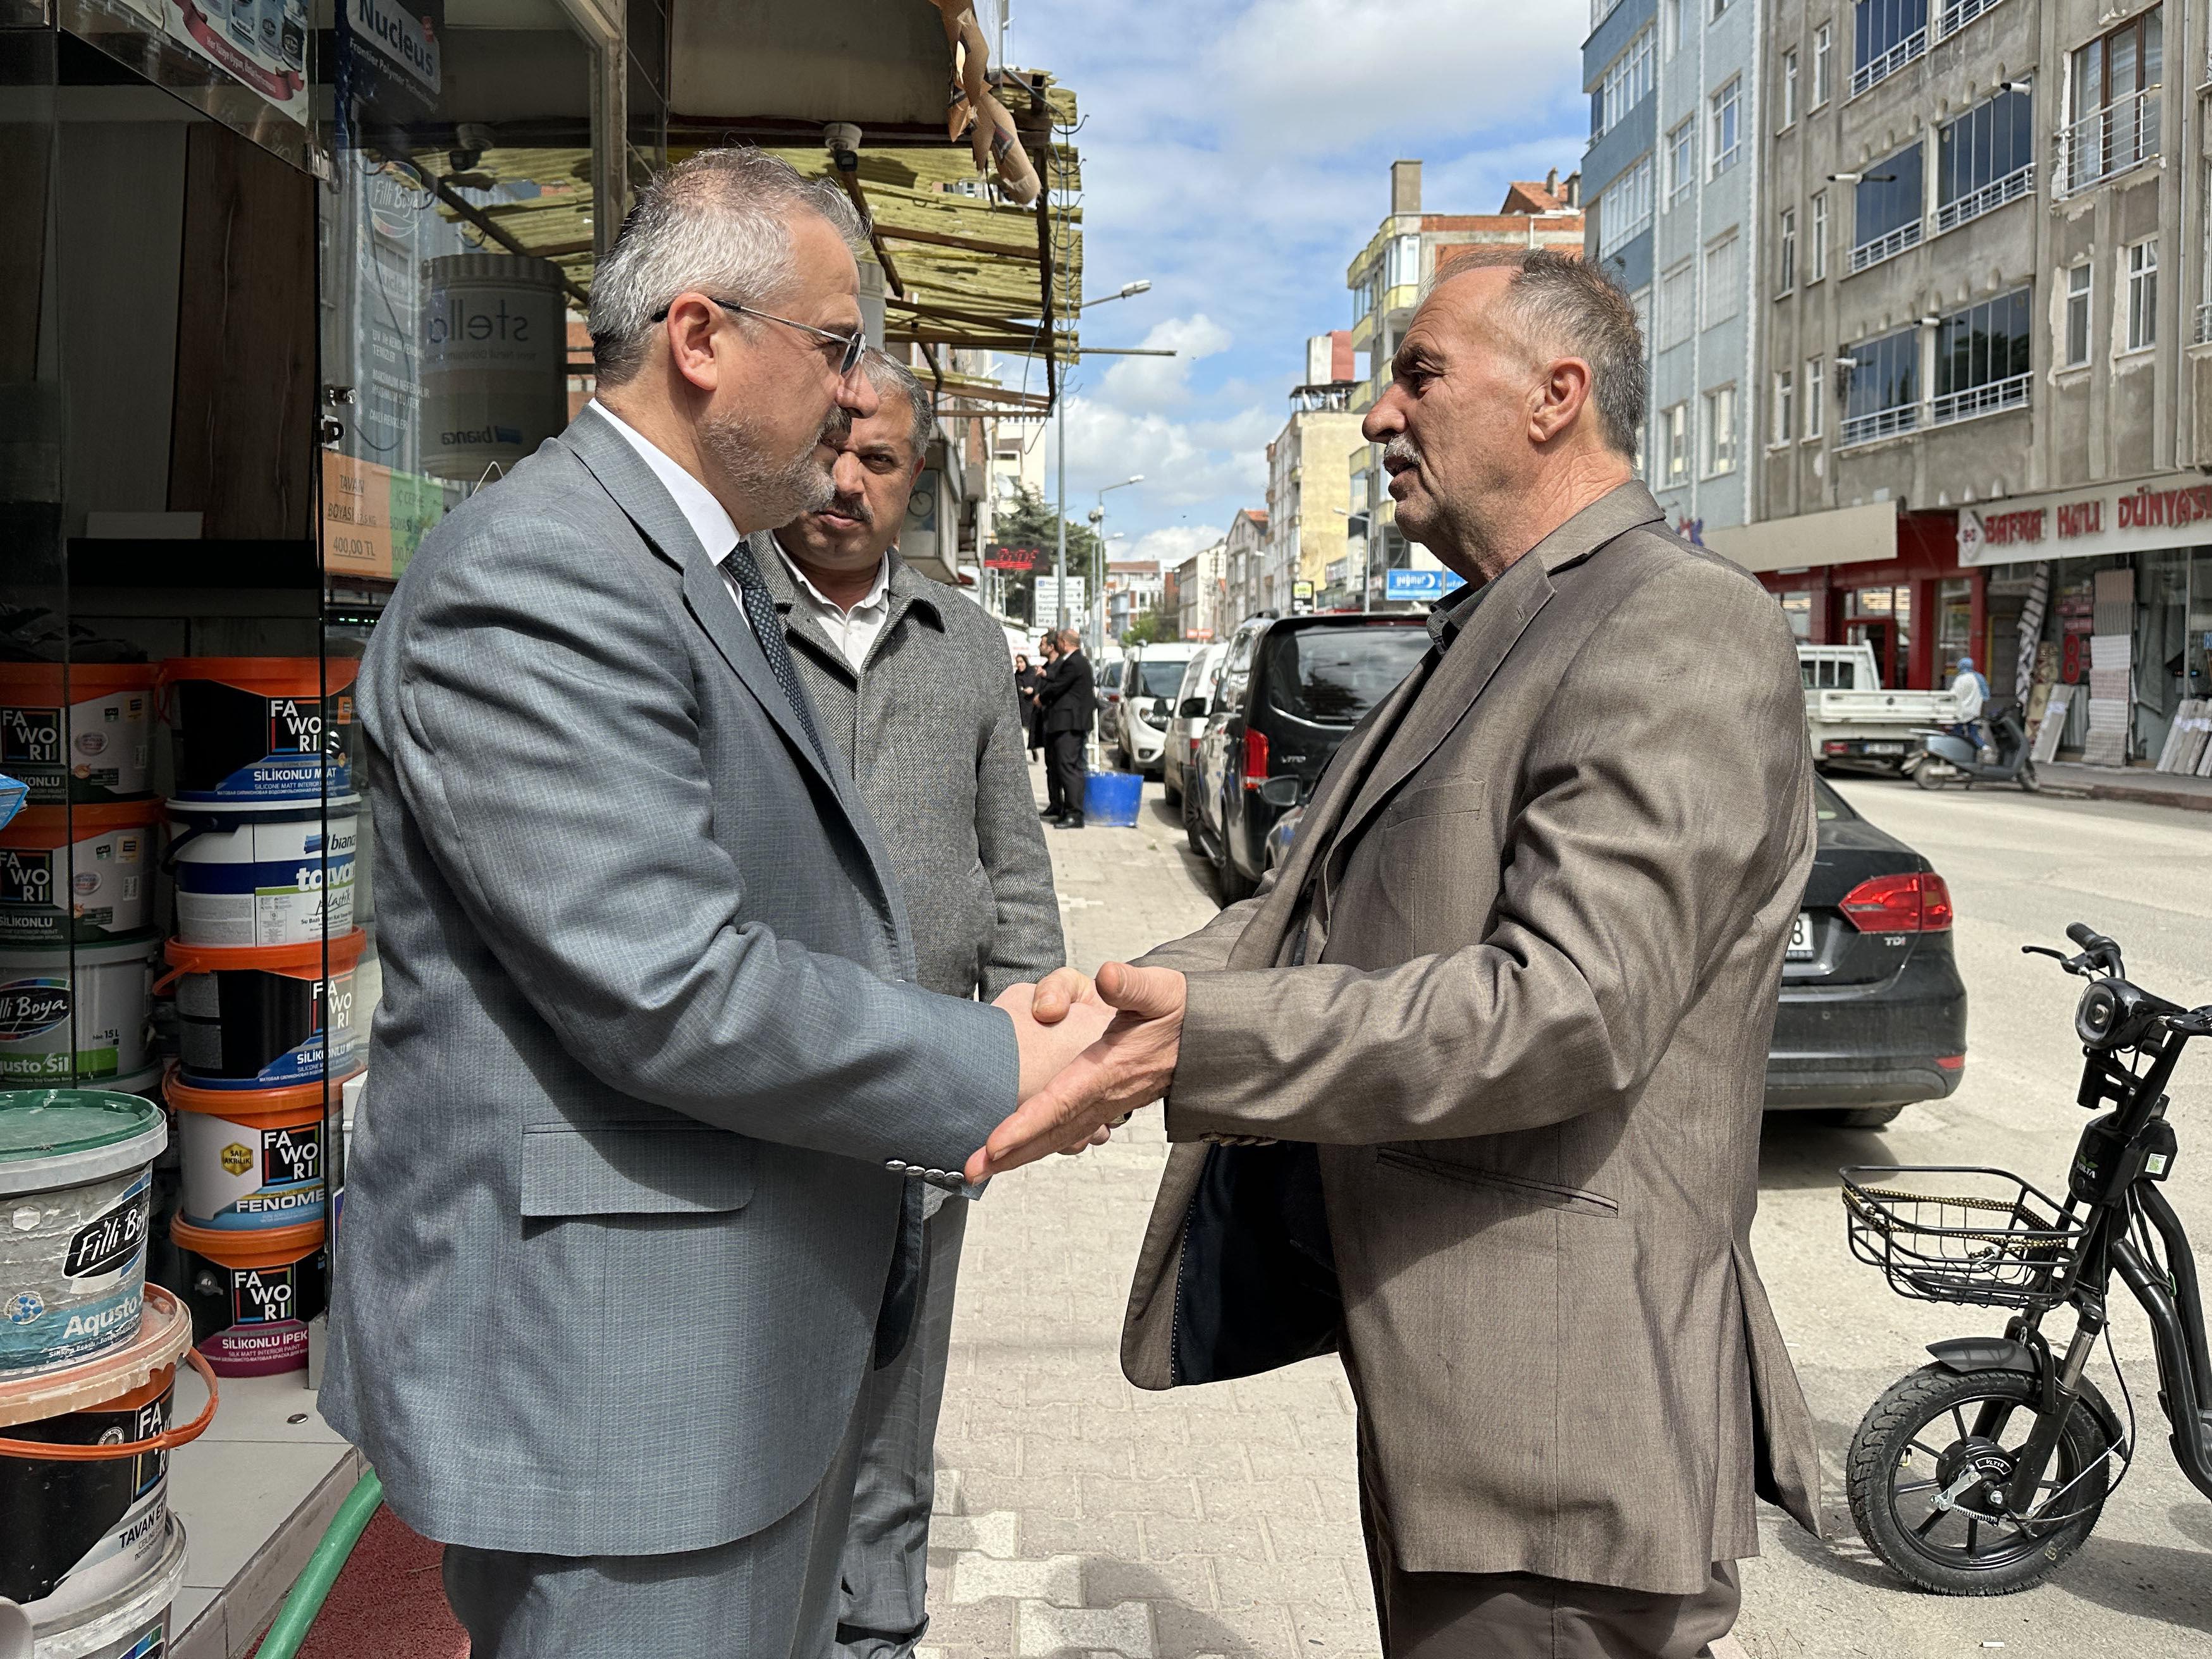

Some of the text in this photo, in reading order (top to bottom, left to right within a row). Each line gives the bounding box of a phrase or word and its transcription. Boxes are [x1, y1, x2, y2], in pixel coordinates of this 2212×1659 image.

[360, 0, 433, 77] Nucleus
[350, 37, 379, 66] Frontier
[374, 180, 391, 206] Filli
[340, 475, 364, 493] TAVAN
[328, 503, 354, 522] BOYASI
[2118, 485, 2212, 528] DÜNYASI
[333, 536, 376, 556] 400,00 TL
[3, 710, 27, 727] FA
[271, 700, 298, 718] FA
[288, 717, 321, 734] WO
[16, 727, 57, 744] WO
[300, 735, 318, 752] RI
[30, 744, 51, 760] RI
[254, 766, 312, 782] SİLİKONLU
[0, 852, 20, 868] FA
[10, 868, 50, 885] WO
[23, 885, 43, 902] RI
[313, 980, 337, 1000] FA
[16, 996, 67, 1021] Boya
[329, 992, 352, 1014] WO
[337, 1010, 349, 1029] RI
[104, 1030, 114, 1039] 15
[264, 1130, 292, 1149] FA
[280, 1142, 318, 1165] WO
[294, 1161, 313, 1180] RI
[2075, 1161, 2096, 1179] VOLTA
[237, 1189, 324, 1213] FENOME
[77, 1204, 149, 1267] Filli Boy
[235, 1271, 262, 1288] FA
[250, 1284, 291, 1305] WO
[63, 1296, 137, 1339] Aqusto
[264, 1302, 285, 1320] RI
[222, 1330, 308, 1349] SİLİKONLU İPEK
[139, 1402, 162, 1440] FA
[119, 1510, 155, 1548] TAVAN
